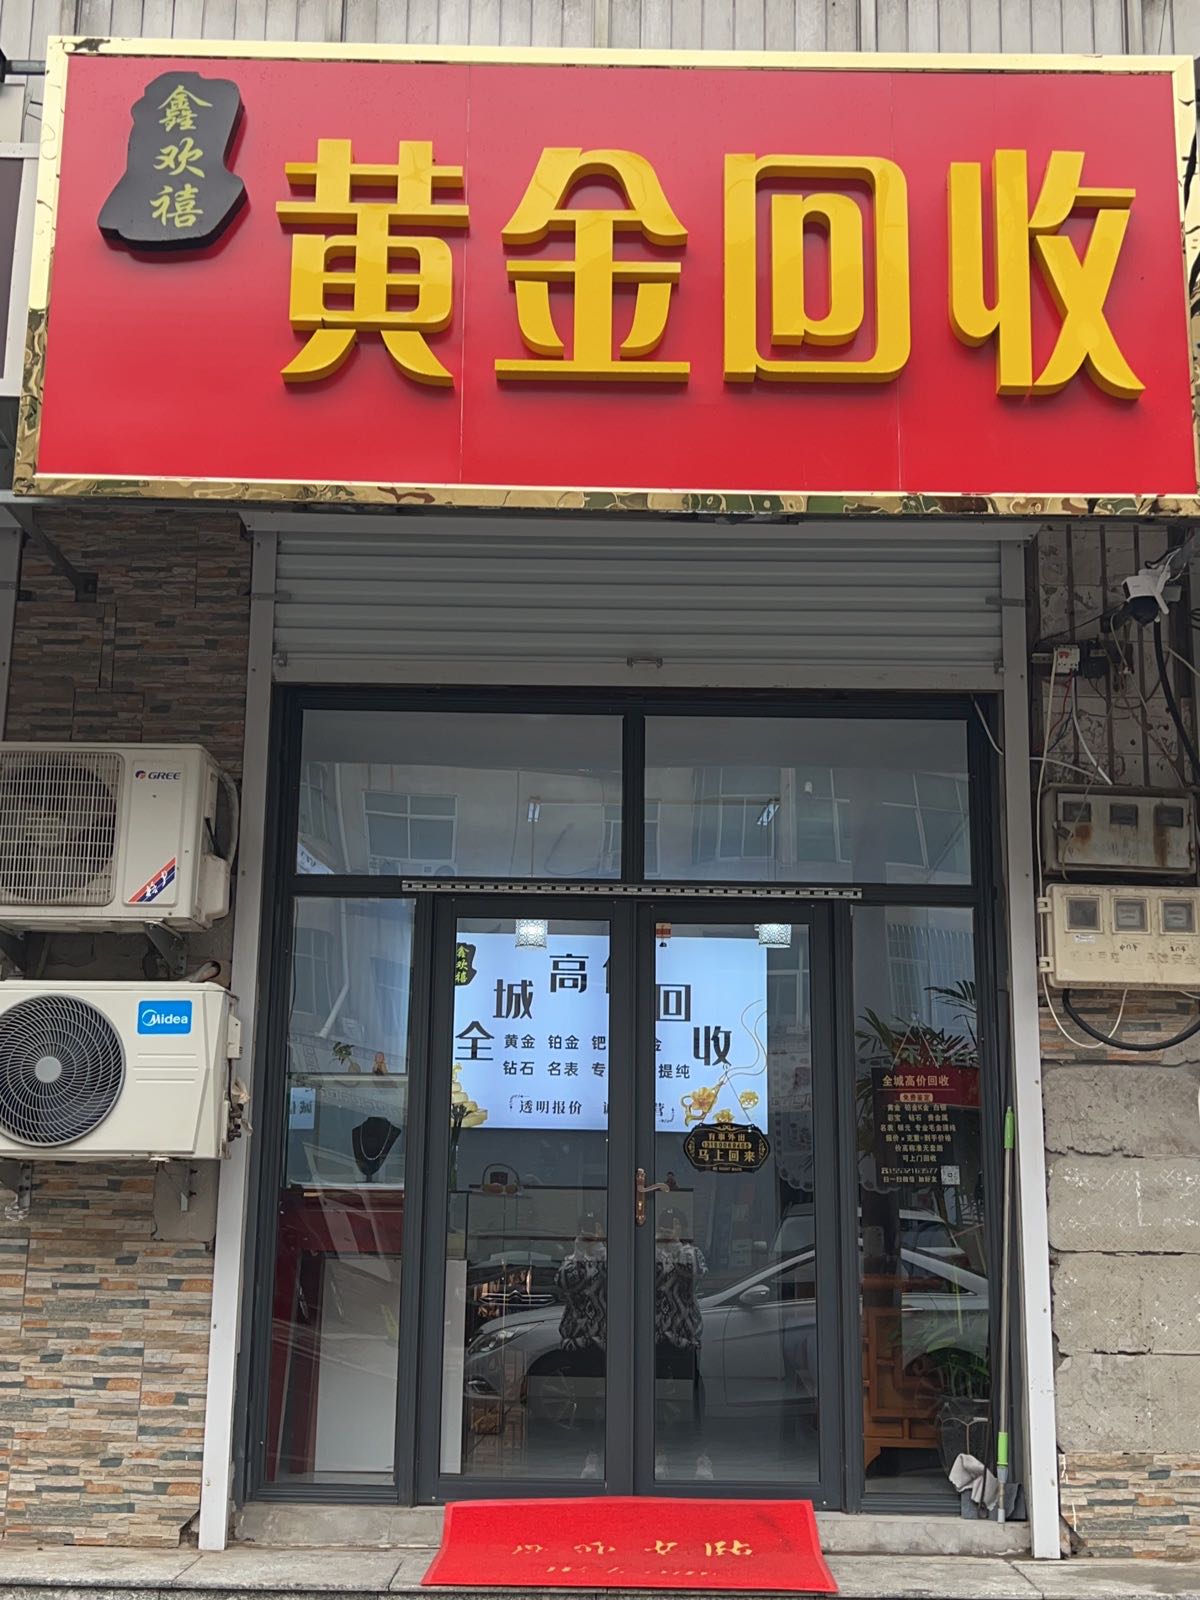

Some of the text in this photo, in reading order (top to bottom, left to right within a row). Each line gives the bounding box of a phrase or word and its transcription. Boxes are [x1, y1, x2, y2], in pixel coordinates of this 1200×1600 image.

[150, 84, 213, 228] 鑫欢禧
[275, 138, 1147, 401] 黄金回收
[148, 771, 182, 780] GREE
[144, 1010, 189, 1025] Midea
[504, 1034, 536, 1049] 黄金
[548, 1035, 580, 1050] 铂金
[503, 1060, 535, 1076] 钻石
[547, 1061, 579, 1077] 名表
[882, 1074, 950, 1087] 全城高价回收
[519, 1100, 582, 1115] 透明报价
